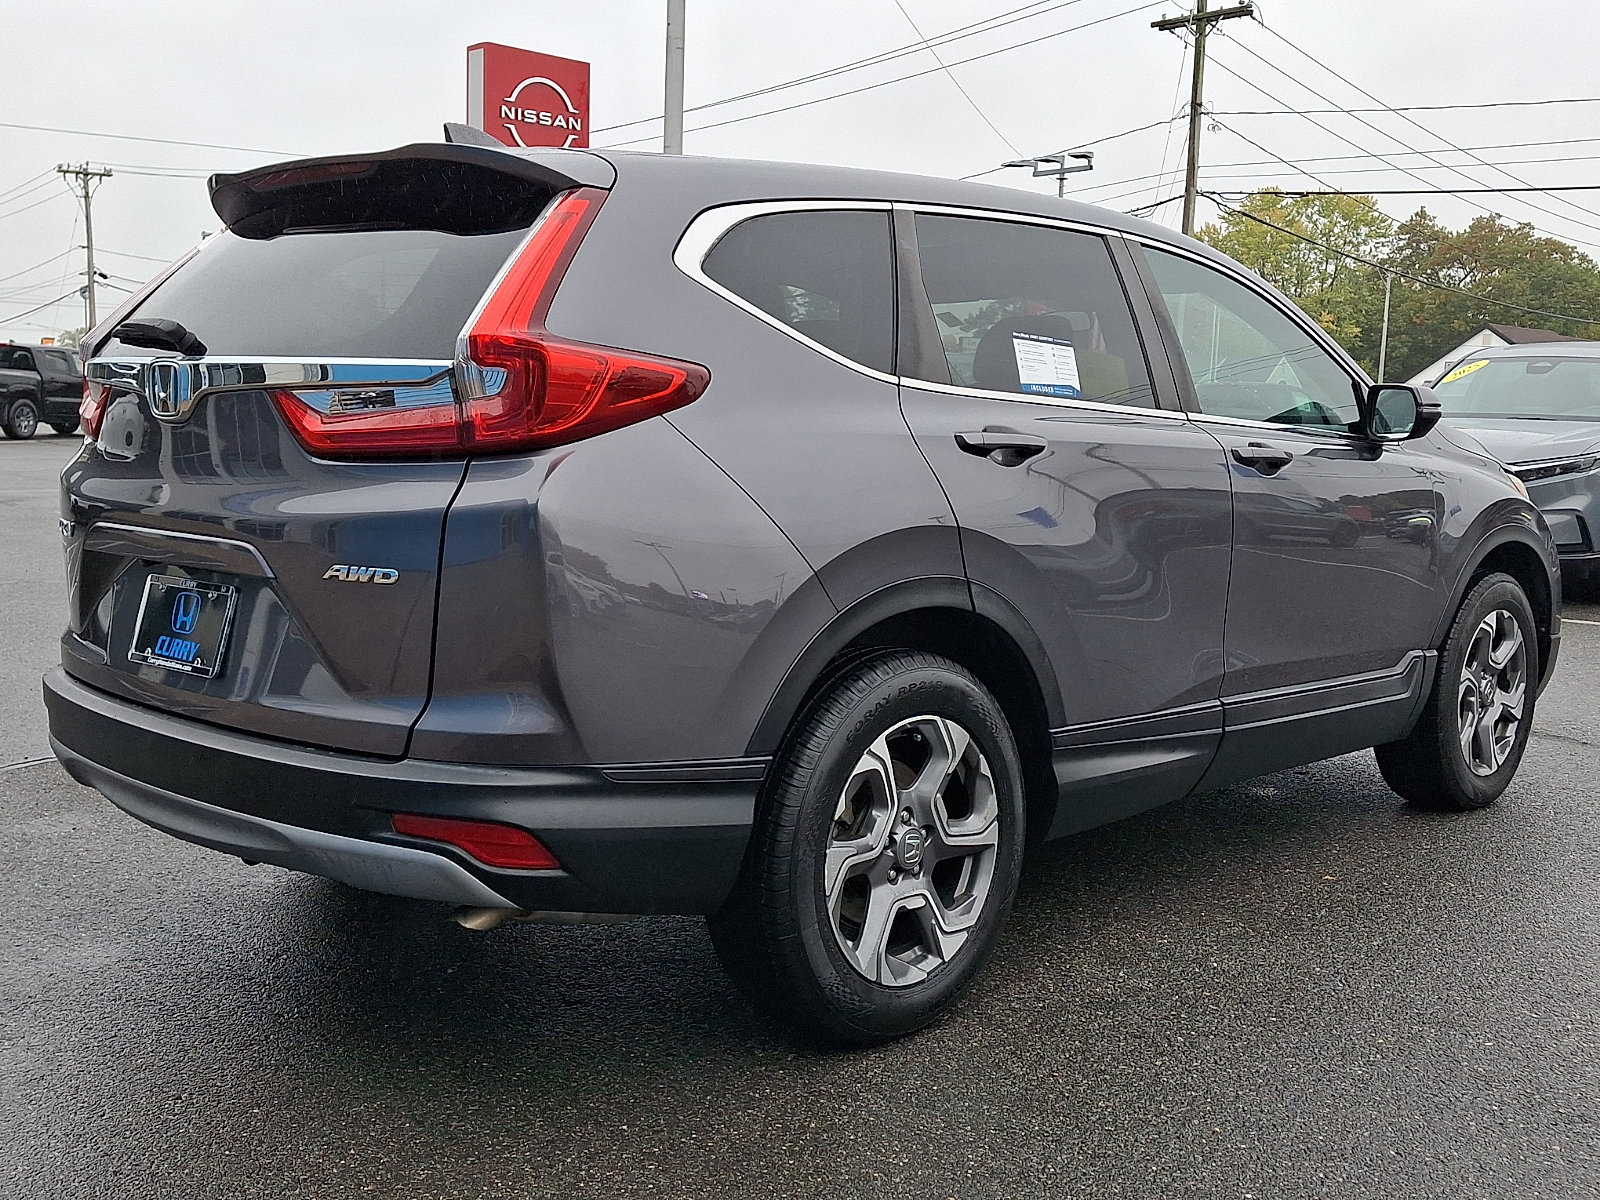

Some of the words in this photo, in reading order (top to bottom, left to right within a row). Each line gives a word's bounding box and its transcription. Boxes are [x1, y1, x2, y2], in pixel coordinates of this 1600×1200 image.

[501, 104, 581, 131] NISSAN
[322, 564, 399, 584] AWD
[154, 635, 200, 662] CURRY
